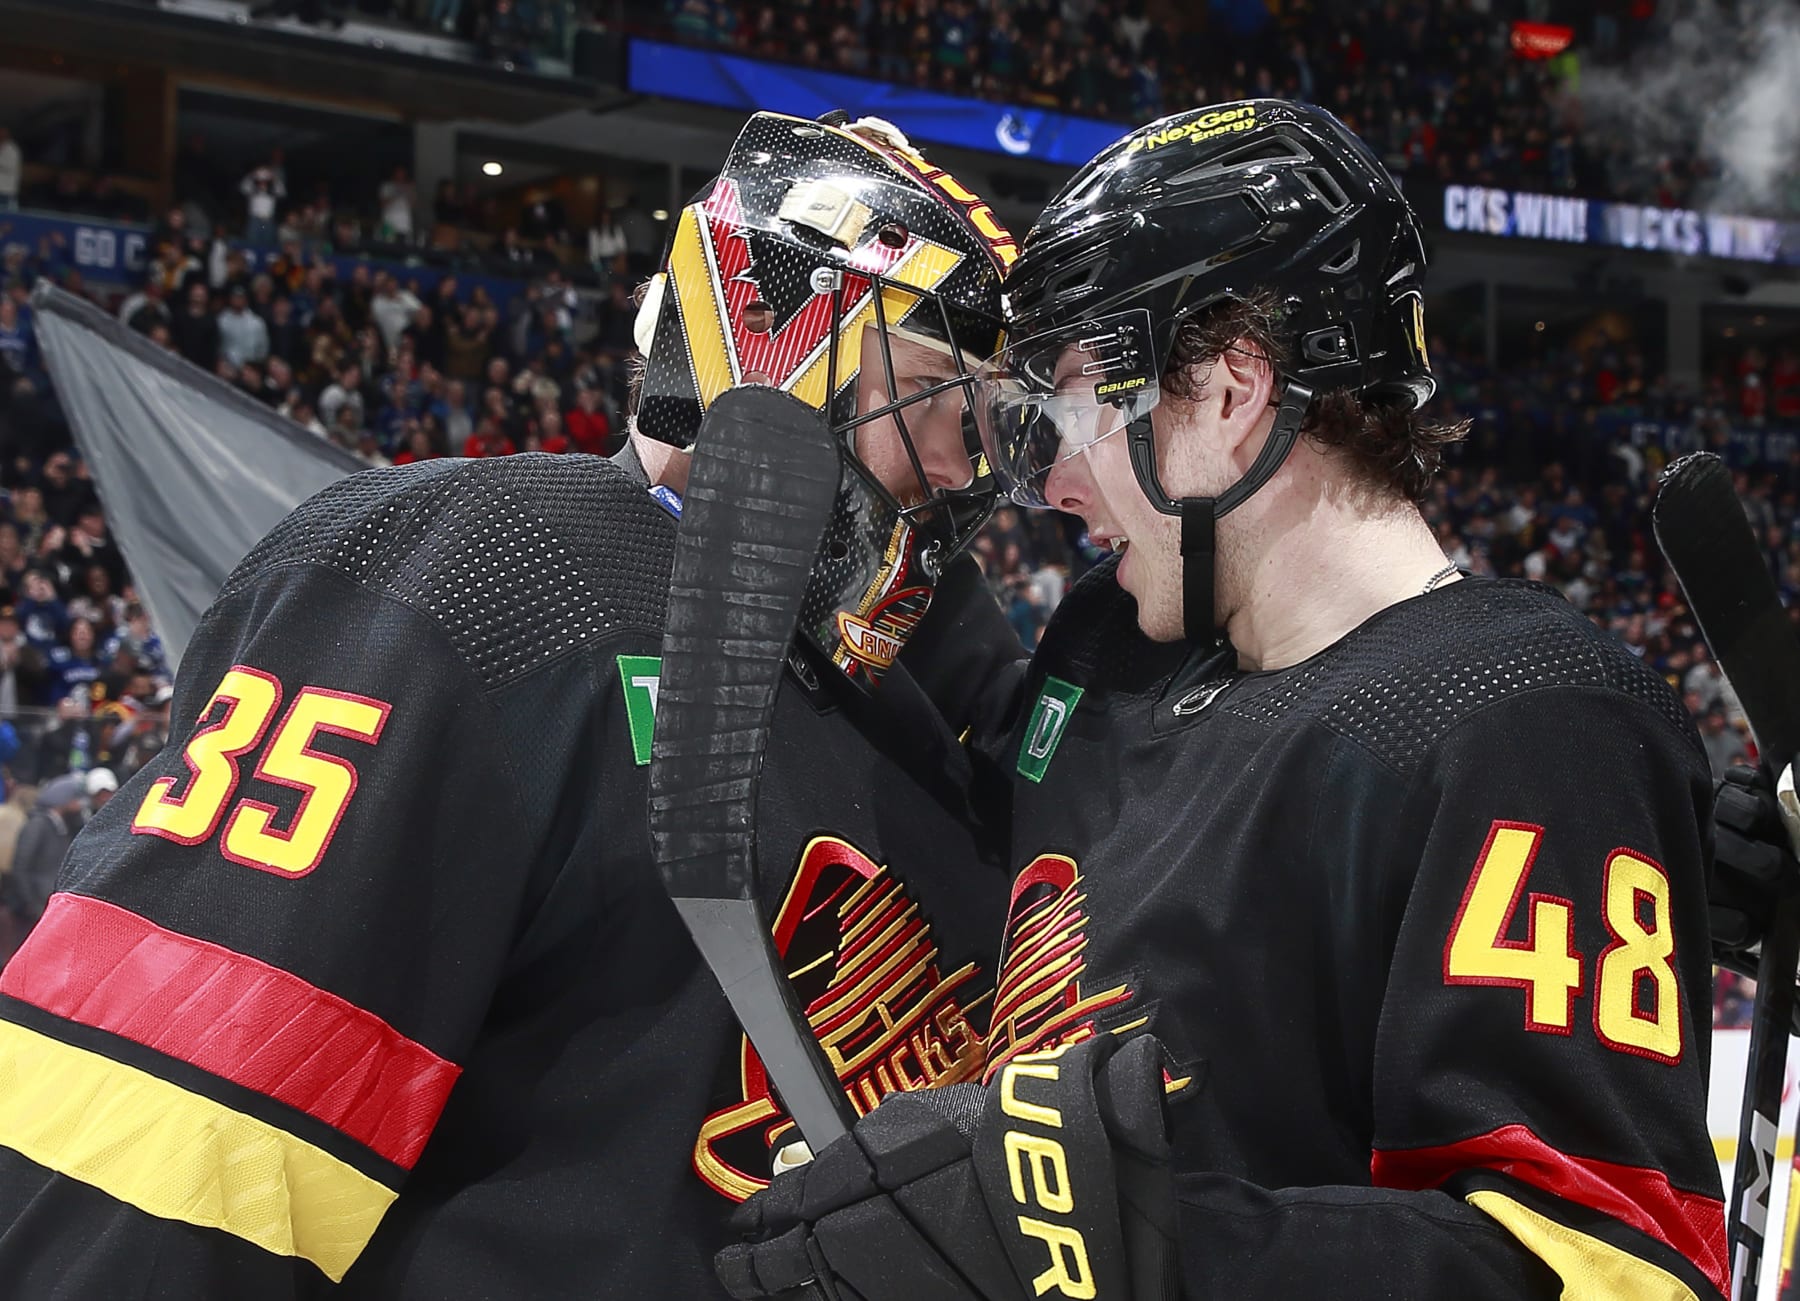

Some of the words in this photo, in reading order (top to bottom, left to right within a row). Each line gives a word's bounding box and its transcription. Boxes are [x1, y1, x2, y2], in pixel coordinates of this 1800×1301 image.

[1146, 105, 1255, 150] NexGen
[1191, 117, 1256, 143] Energy
[1513, 192, 1588, 243] WIN!
[1097, 377, 1147, 395] BAUER
[130, 664, 393, 880] 35
[1443, 819, 1684, 1067] 48
[1000, 1042, 1098, 1300] UER
